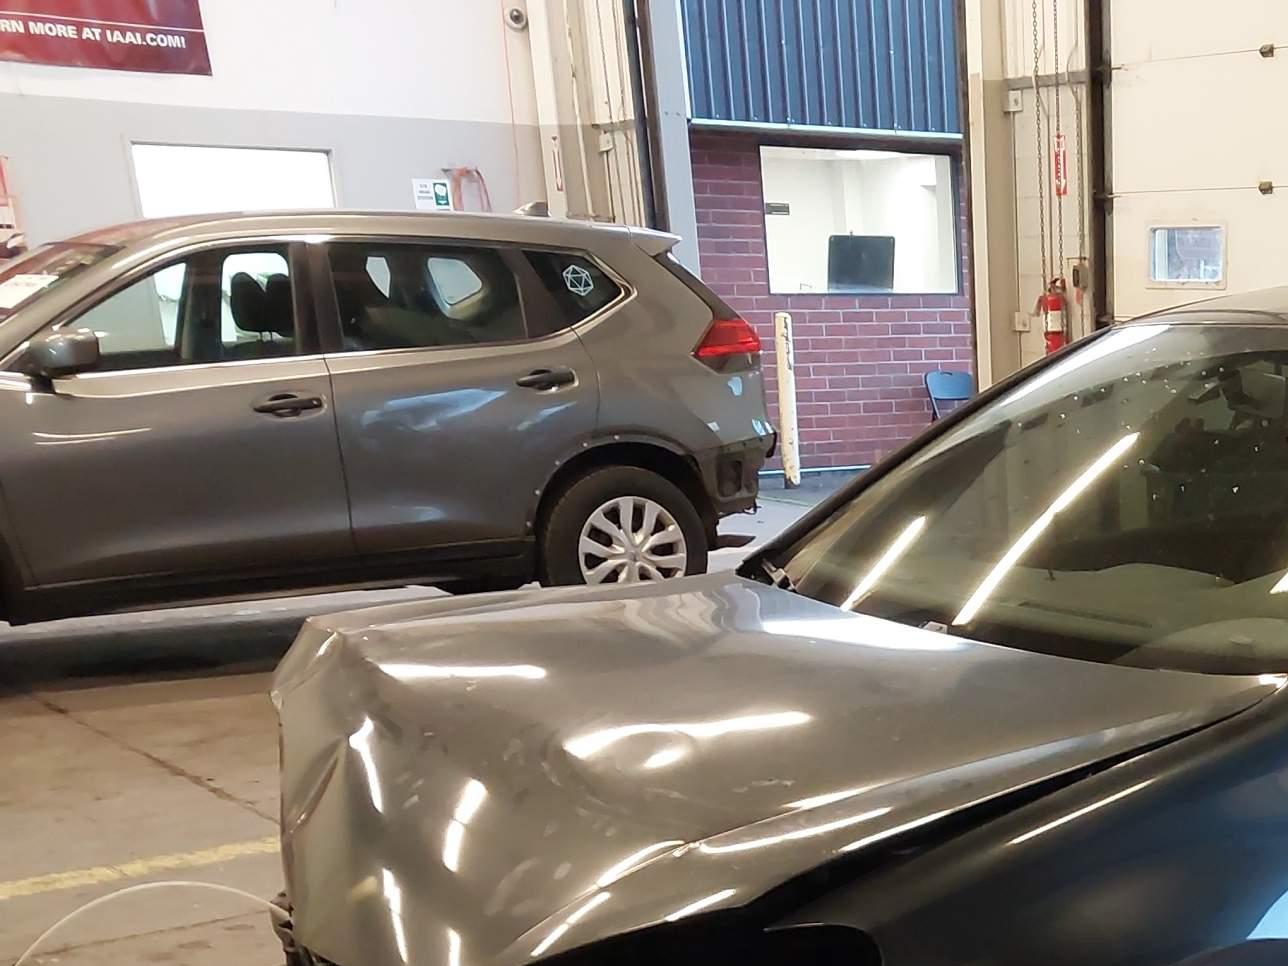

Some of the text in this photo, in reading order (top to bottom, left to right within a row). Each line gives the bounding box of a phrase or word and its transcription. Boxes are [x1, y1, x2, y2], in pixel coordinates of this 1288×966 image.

[28, 21, 78, 38] MORE
[82, 28, 101, 41] AT
[106, 29, 186, 48] IAAI.COM!
